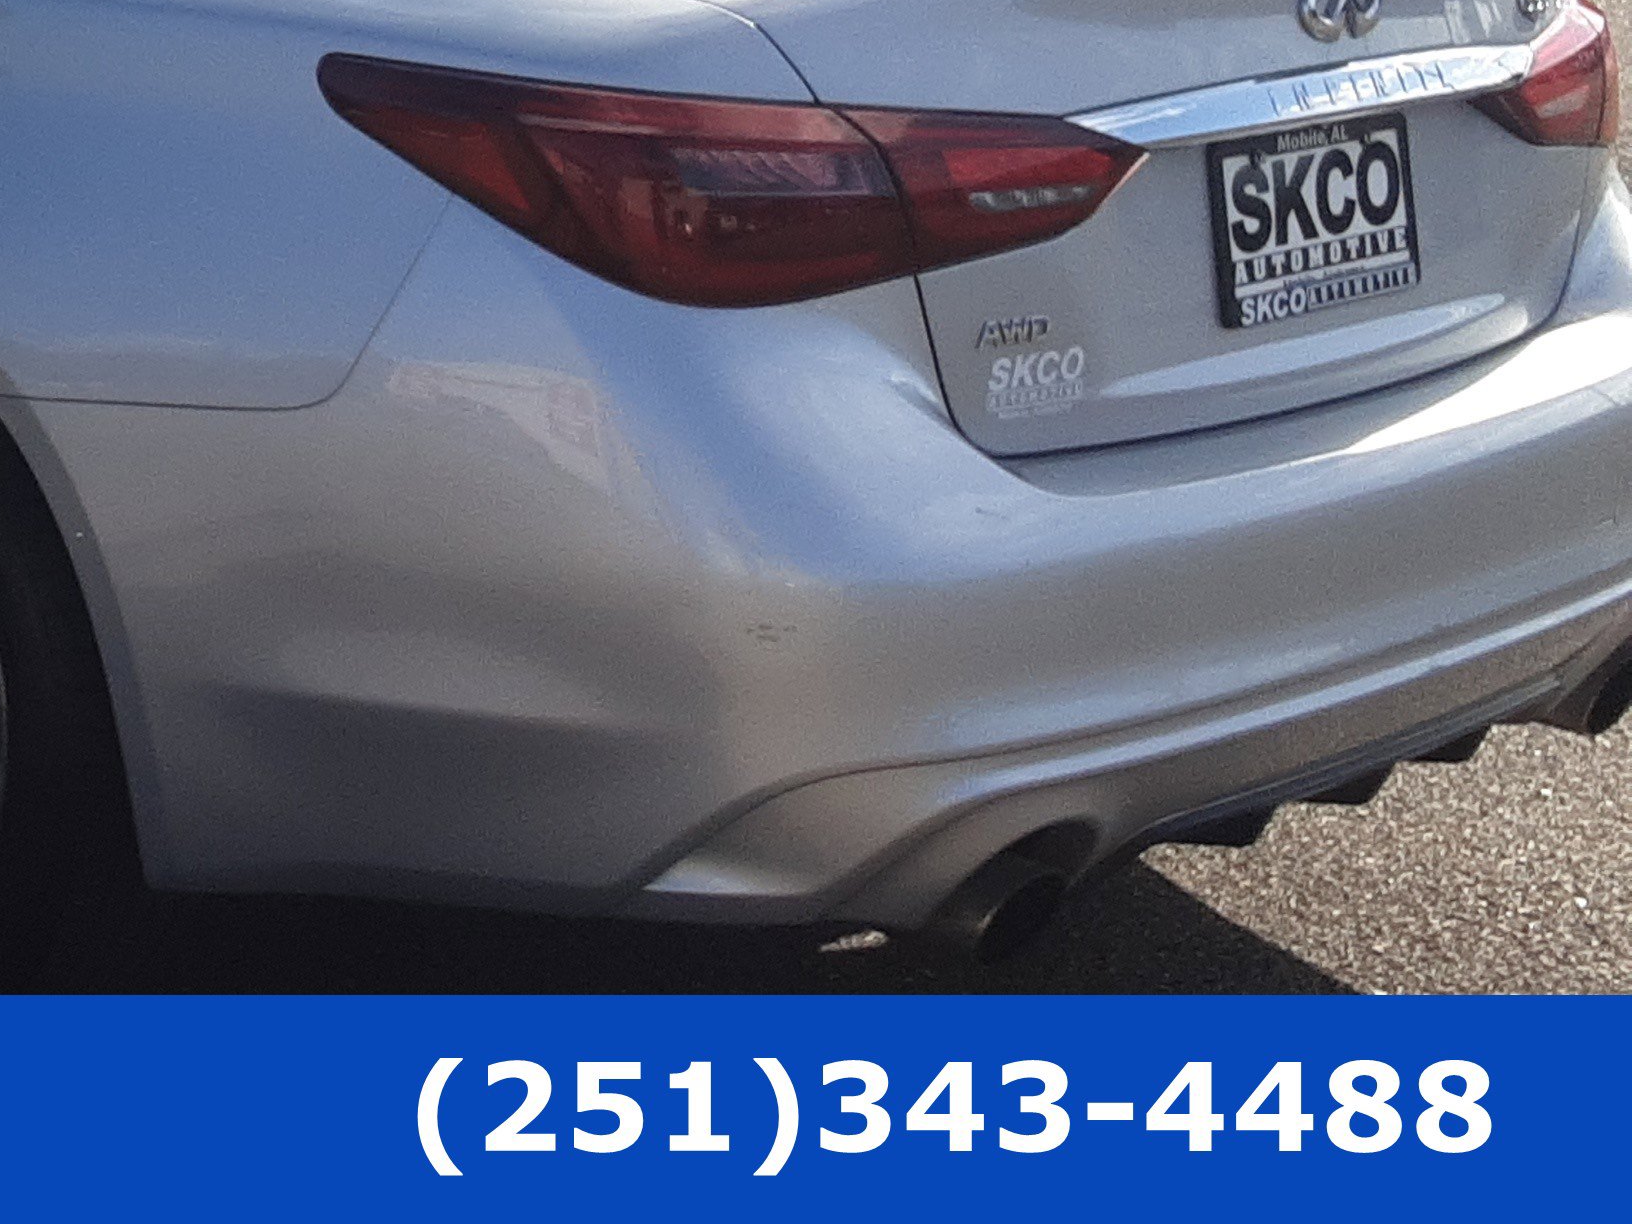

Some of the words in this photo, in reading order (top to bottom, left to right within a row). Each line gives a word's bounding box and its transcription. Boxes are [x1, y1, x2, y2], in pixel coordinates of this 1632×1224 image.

[1231, 140, 1400, 253] SKCO
[1233, 226, 1408, 285] AUTOMOTIVE
[1240, 287, 1307, 327] SKCO
[988, 346, 1085, 392] SKCO
